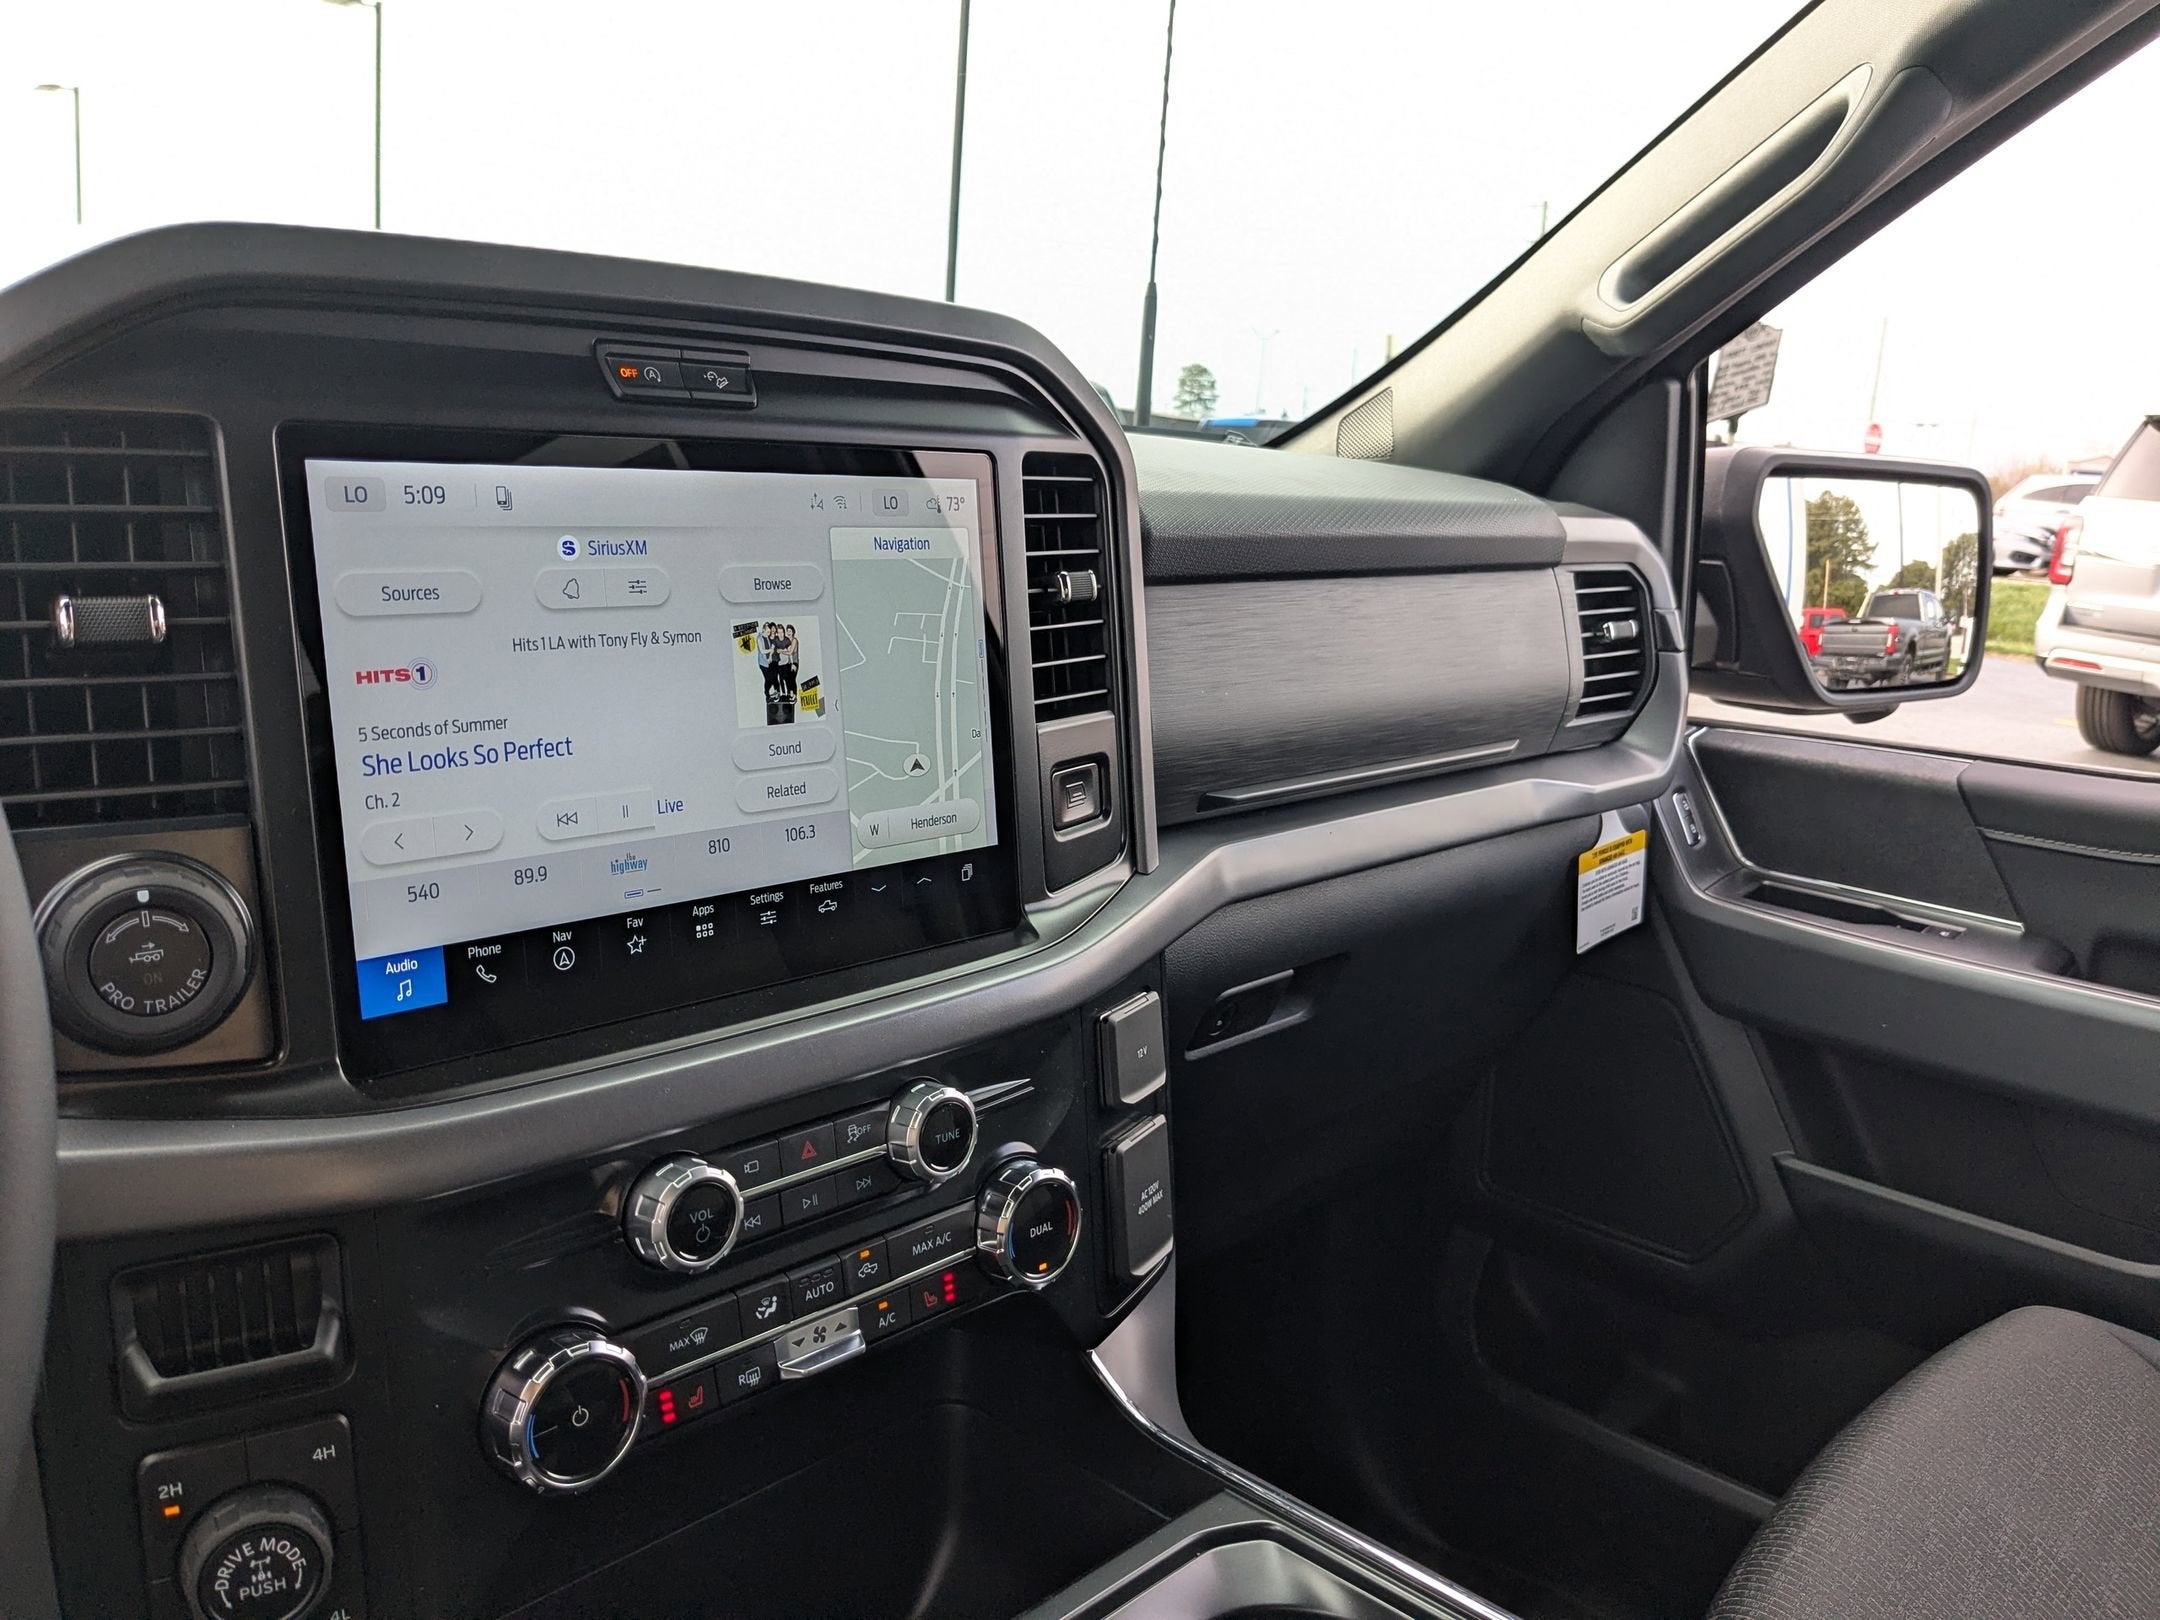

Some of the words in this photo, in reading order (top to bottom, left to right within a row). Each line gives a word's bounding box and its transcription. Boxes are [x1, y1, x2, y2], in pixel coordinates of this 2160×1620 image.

[620, 368, 637, 378] OFF
[344, 486, 367, 504] LO
[403, 485, 446, 505] 5:09
[883, 495, 898, 510] LO
[946, 496, 965, 511] 73°
[587, 540, 648, 556] SiriusXM
[873, 536, 931, 552] Navigation
[753, 578, 792, 592] Browse
[381, 586, 440, 602] Sources
[512, 637, 538, 652] Hits
[541, 637, 546, 651] 1
[548, 635, 566, 650] LA
[568, 634, 596, 649] with
[598, 634, 628, 649] Tony
[631, 631, 648, 647] Fly
[650, 631, 661, 645] &
[662, 630, 702, 645] Symon
[355, 668, 410, 685] HITS
[415, 666, 426, 681] 1
[358, 727, 367, 742] 5
[371, 722, 431, 741] Seconds
[434, 720, 450, 736] of
[452, 717, 508, 735] Summer
[362, 754, 402, 777] She
[408, 747, 469, 772] Looks
[474, 744, 499, 765] So
[504, 736, 573, 762] Perfect
[768, 741, 802, 757] Sound
[766, 782, 807, 799] Related
[364, 793, 389, 810] Ch.
[391, 792, 401, 807] 2
[656, 799, 684, 815] Live
[910, 812, 957, 830] Henderson
[785, 825, 816, 842] 106.3
[869, 823, 880, 836] W
[708, 838, 731, 854] 810
[610, 858, 648, 875] highway
[514, 866, 548, 886] 89.9
[407, 882, 440, 903] 540
[809, 880, 843, 894] Features
[750, 890, 784, 906] Settings
[692, 903, 714, 917] Apps
[626, 917, 644, 929] Fav
[552, 931, 572, 943] Nav
[467, 943, 502, 959] Phone
[385, 959, 418, 975] Audio
[100, 982, 135, 1010] PRO
[144, 968, 207, 1014] TRAILER
[857, 1124, 872, 1135] OFF
[935, 1128, 961, 1144] TUNE
[689, 1208, 714, 1223] VOL
[1029, 1221, 1054, 1238] DUAL
[912, 1239, 934, 1256] MAX
[935, 1231, 952, 1246] A/C
[804, 1281, 835, 1302] AUTO
[878, 1312, 897, 1328] A/C
[668, 1337, 691, 1352] MAX
[738, 1374, 746, 1386] R
[312, 1445, 336, 1461] 4H
[158, 1482, 183, 1499] 2H
[215, 1542, 255, 1590] DRIVE
[260, 1537, 306, 1571] MODE
[239, 1577, 287, 1601] PUSH
